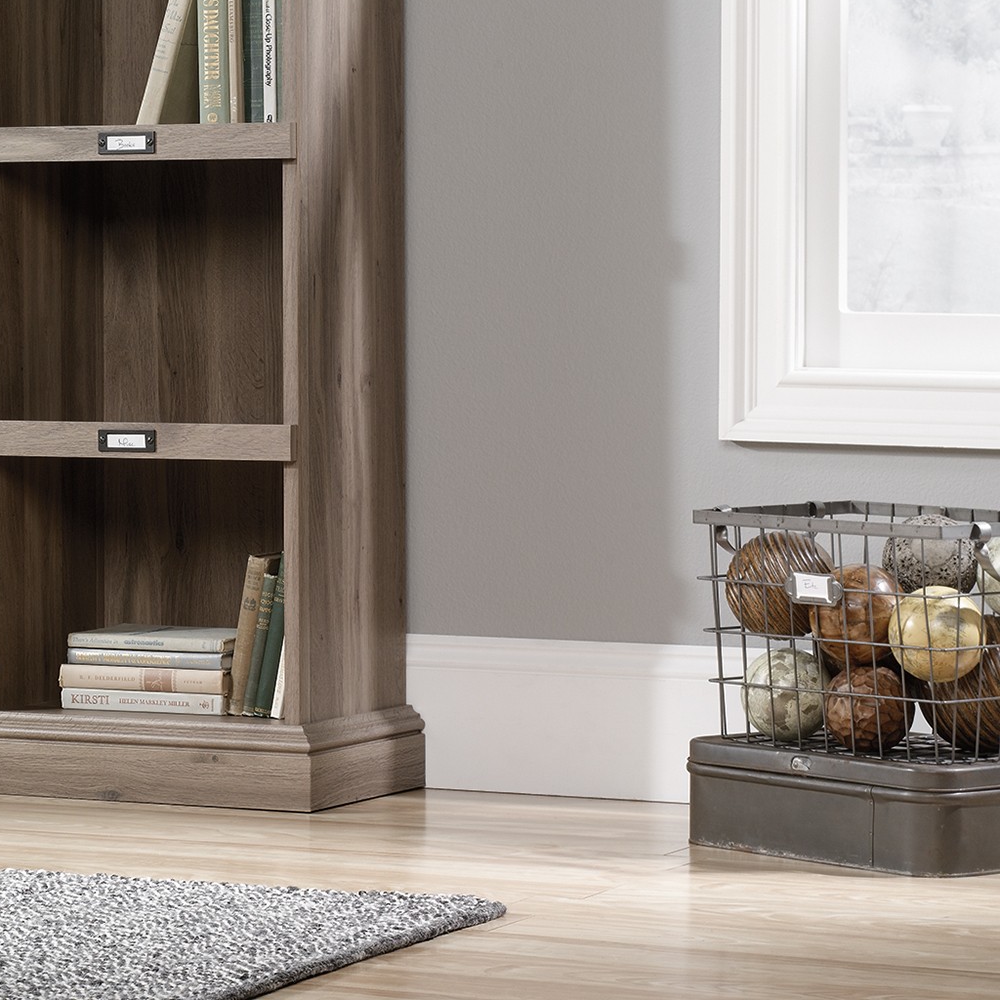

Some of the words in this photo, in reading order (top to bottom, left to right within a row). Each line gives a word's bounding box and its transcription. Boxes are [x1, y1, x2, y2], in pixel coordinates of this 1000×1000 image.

[203, 9, 220, 81] DAUGHTER
[265, 13, 273, 43] Close-Up
[265, 44, 273, 87] Photography
[71, 693, 110, 705] KIRSTI
[119, 697, 139, 705] HELEN
[139, 698, 168, 706] MARKLEY
